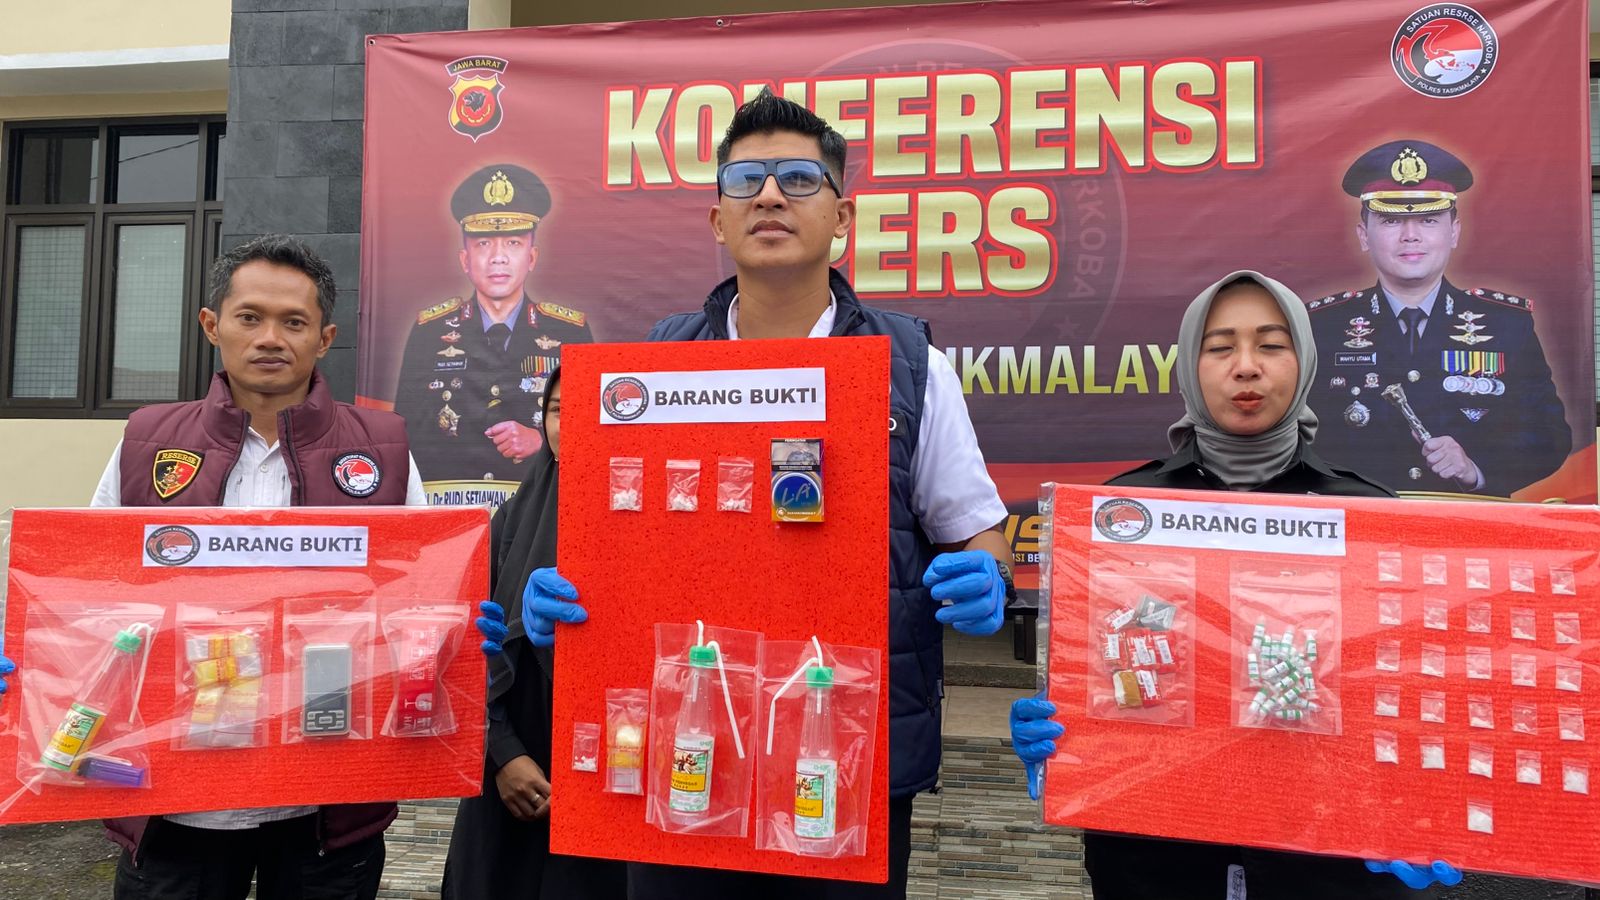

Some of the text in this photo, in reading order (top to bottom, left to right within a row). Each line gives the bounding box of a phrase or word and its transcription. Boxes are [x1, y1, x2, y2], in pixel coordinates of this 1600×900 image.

[1406, 8, 1494, 65] SATUAN RESRSE NARKOBA
[453, 59, 502, 72] JAWA BARAT
[1416, 74, 1481, 94] POLRES TASIKMALAYA
[606, 59, 1259, 187] KOFERENSI
[829, 186, 1052, 293] ERS
[654, 387, 818, 406] BARANG BUKTI
[444, 491, 464, 505] RUDI
[1161, 512, 1339, 539] BARANG BUKTI
[207, 537, 363, 553] BARANG BUKTI
